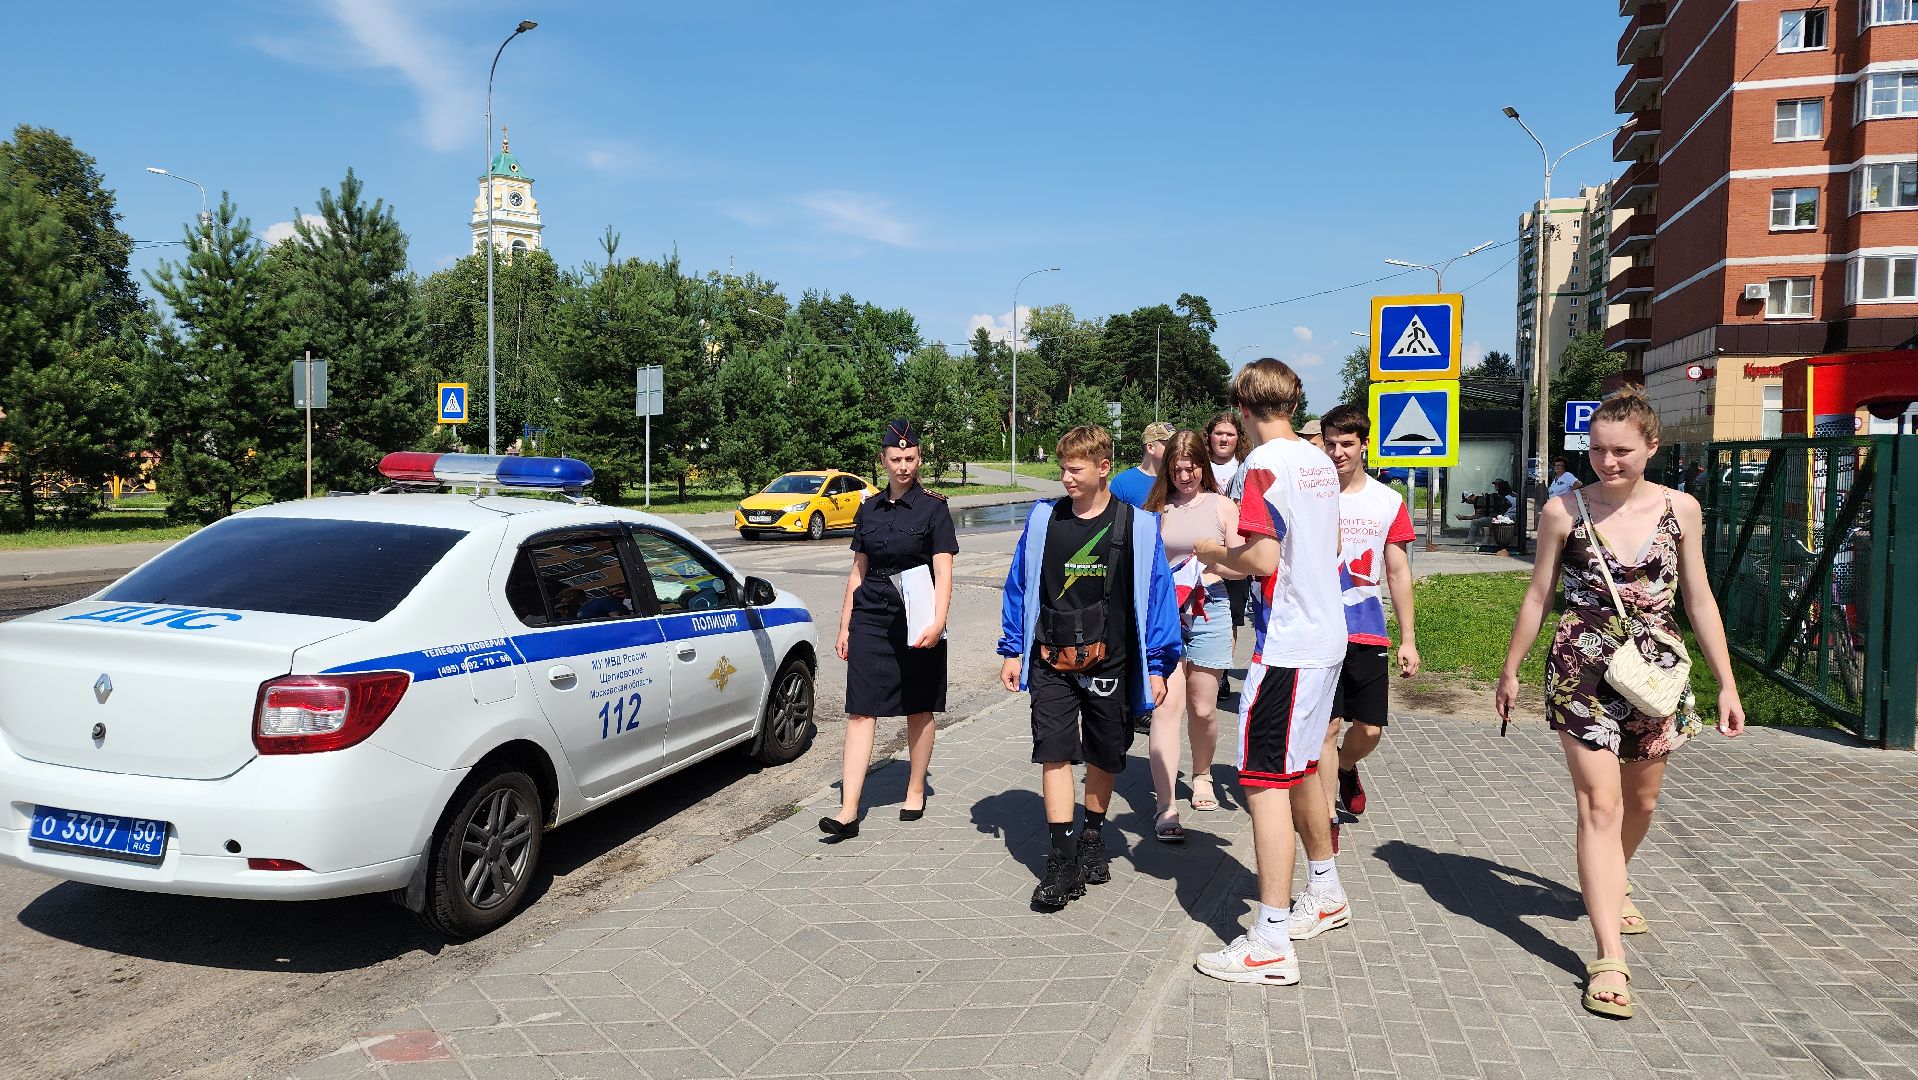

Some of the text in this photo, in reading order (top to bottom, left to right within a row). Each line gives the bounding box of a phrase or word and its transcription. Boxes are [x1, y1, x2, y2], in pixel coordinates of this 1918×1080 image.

[57, 605, 243, 630] ДПС
[691, 613, 738, 632] ПОЛИЦИЯ
[422, 638, 507, 658] ТЕЛЕФОН ДОВЕРИЯ
[591, 651, 648, 671] МУ МВД России
[589, 685, 629, 700] Московская
[598, 692, 642, 740] 112
[61, 812, 120, 845] 3307
[132, 820, 157, 843] 50
[132, 842, 151, 852] RUS
